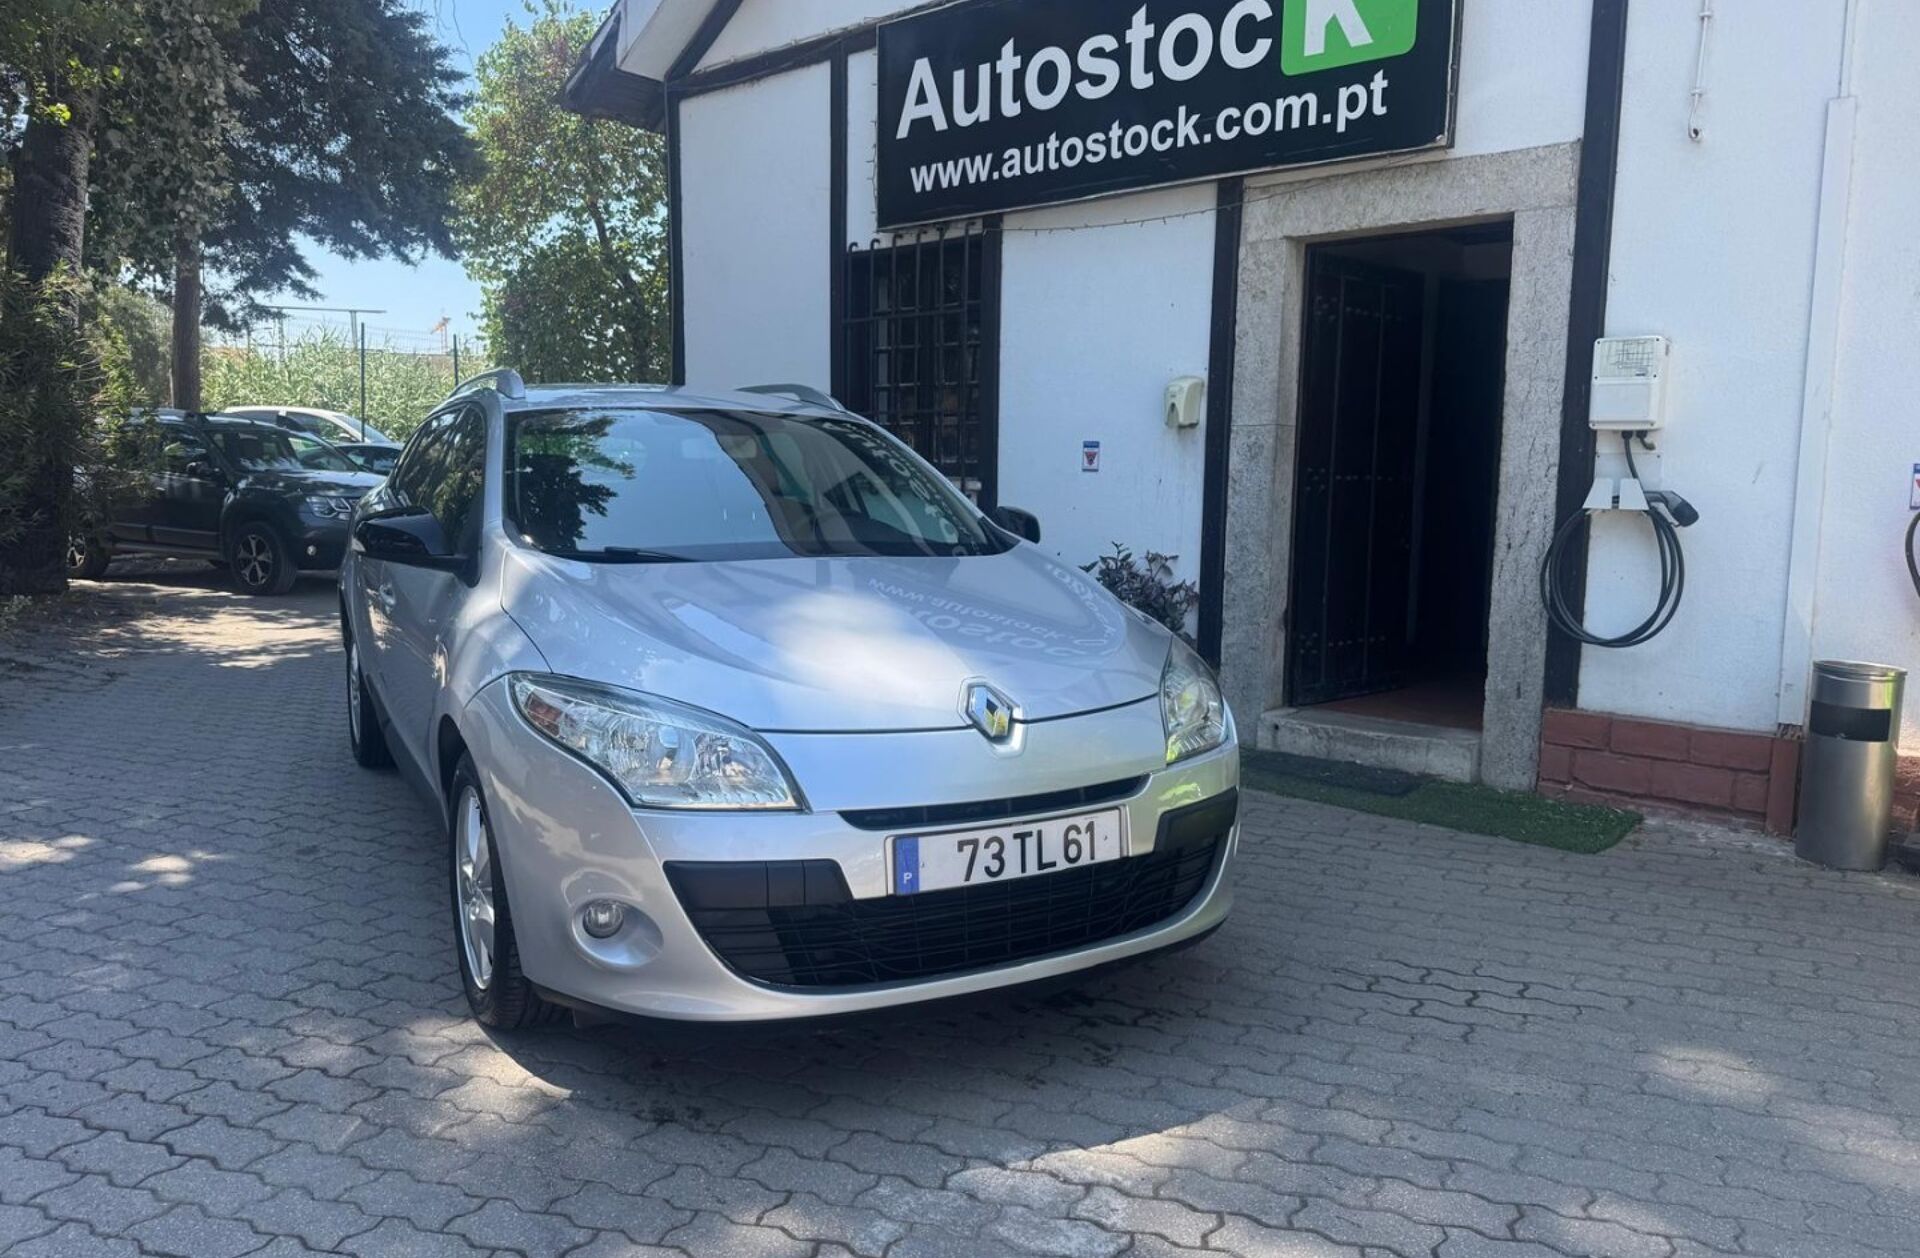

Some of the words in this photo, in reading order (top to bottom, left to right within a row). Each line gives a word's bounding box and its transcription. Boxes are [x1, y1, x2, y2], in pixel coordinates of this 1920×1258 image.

[910, 70, 1388, 193] www.autostock.com.pt
[903, 872, 912, 884] P
[957, 837, 1006, 882] 73
[1012, 829, 1057, 874] TL
[1064, 820, 1095, 864] 61
